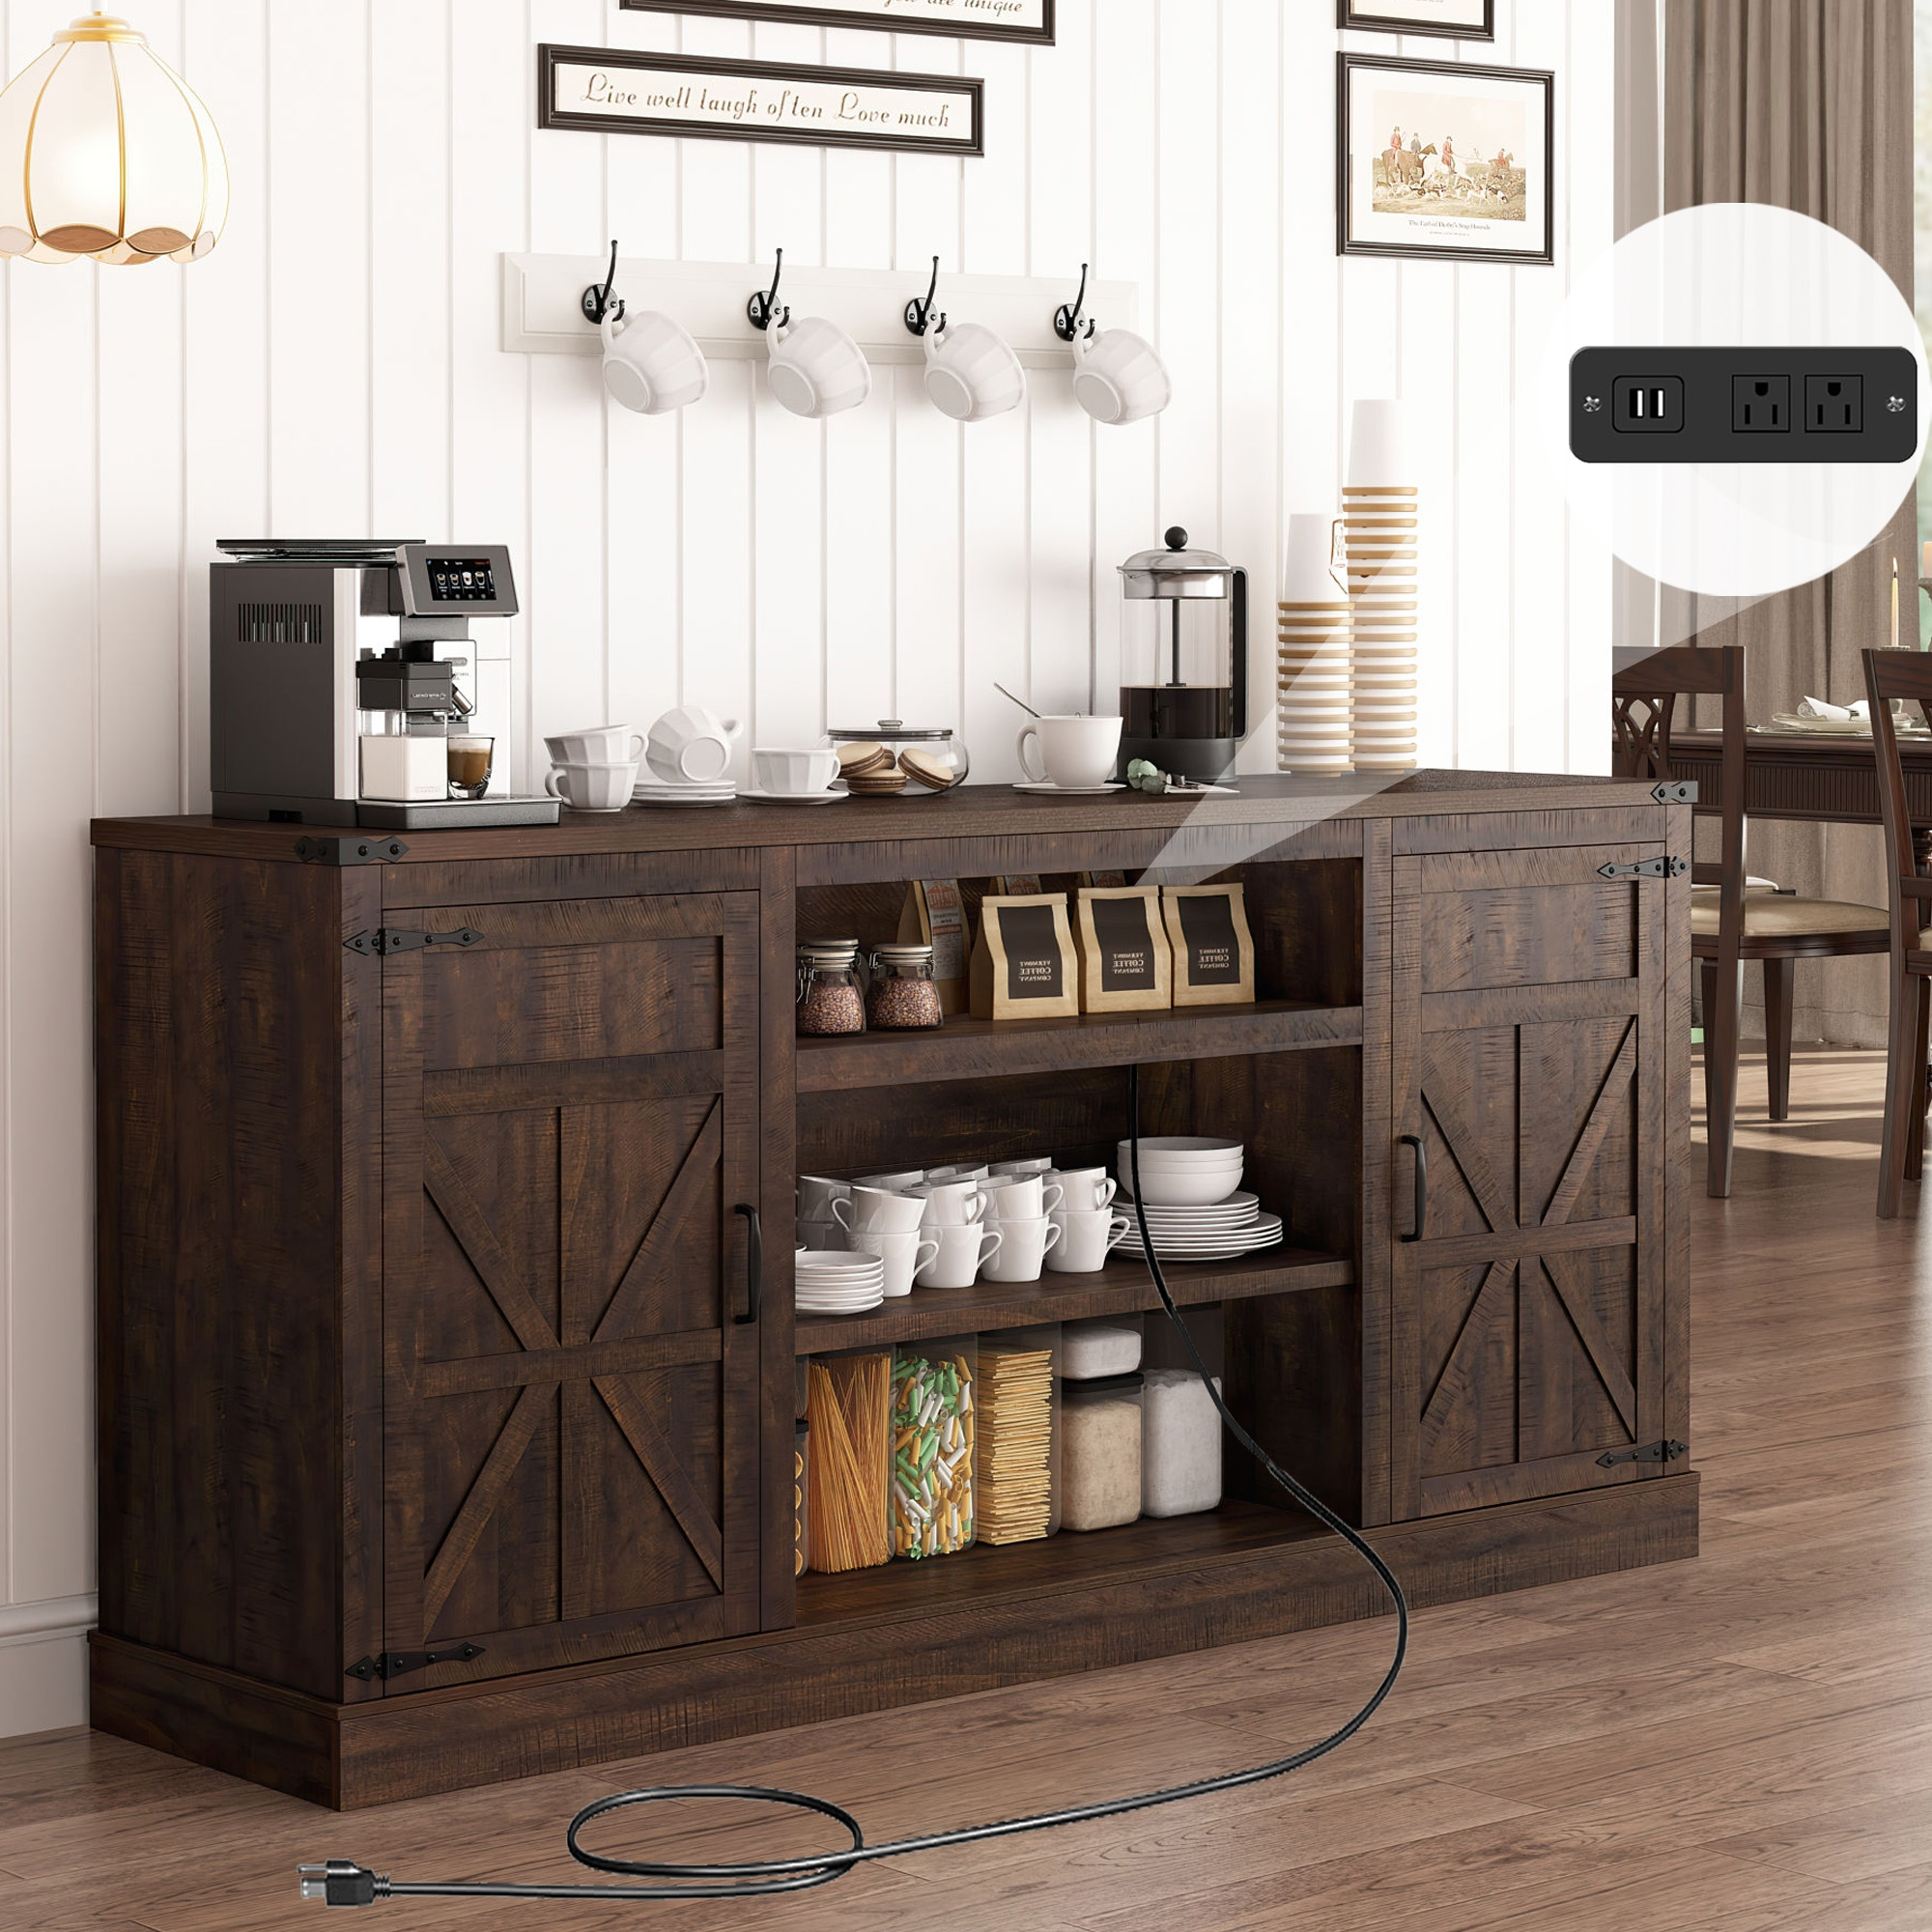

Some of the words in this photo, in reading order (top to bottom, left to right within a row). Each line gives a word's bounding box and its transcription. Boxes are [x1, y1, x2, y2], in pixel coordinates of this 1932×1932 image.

[964, 0, 1022, 17] unique
[582, 72, 637, 105] Live
[646, 87, 691, 108] well
[699, 88, 757, 121] laugh
[767, 90, 823, 122] often
[834, 92, 890, 123] Love
[898, 104, 949, 128] much
